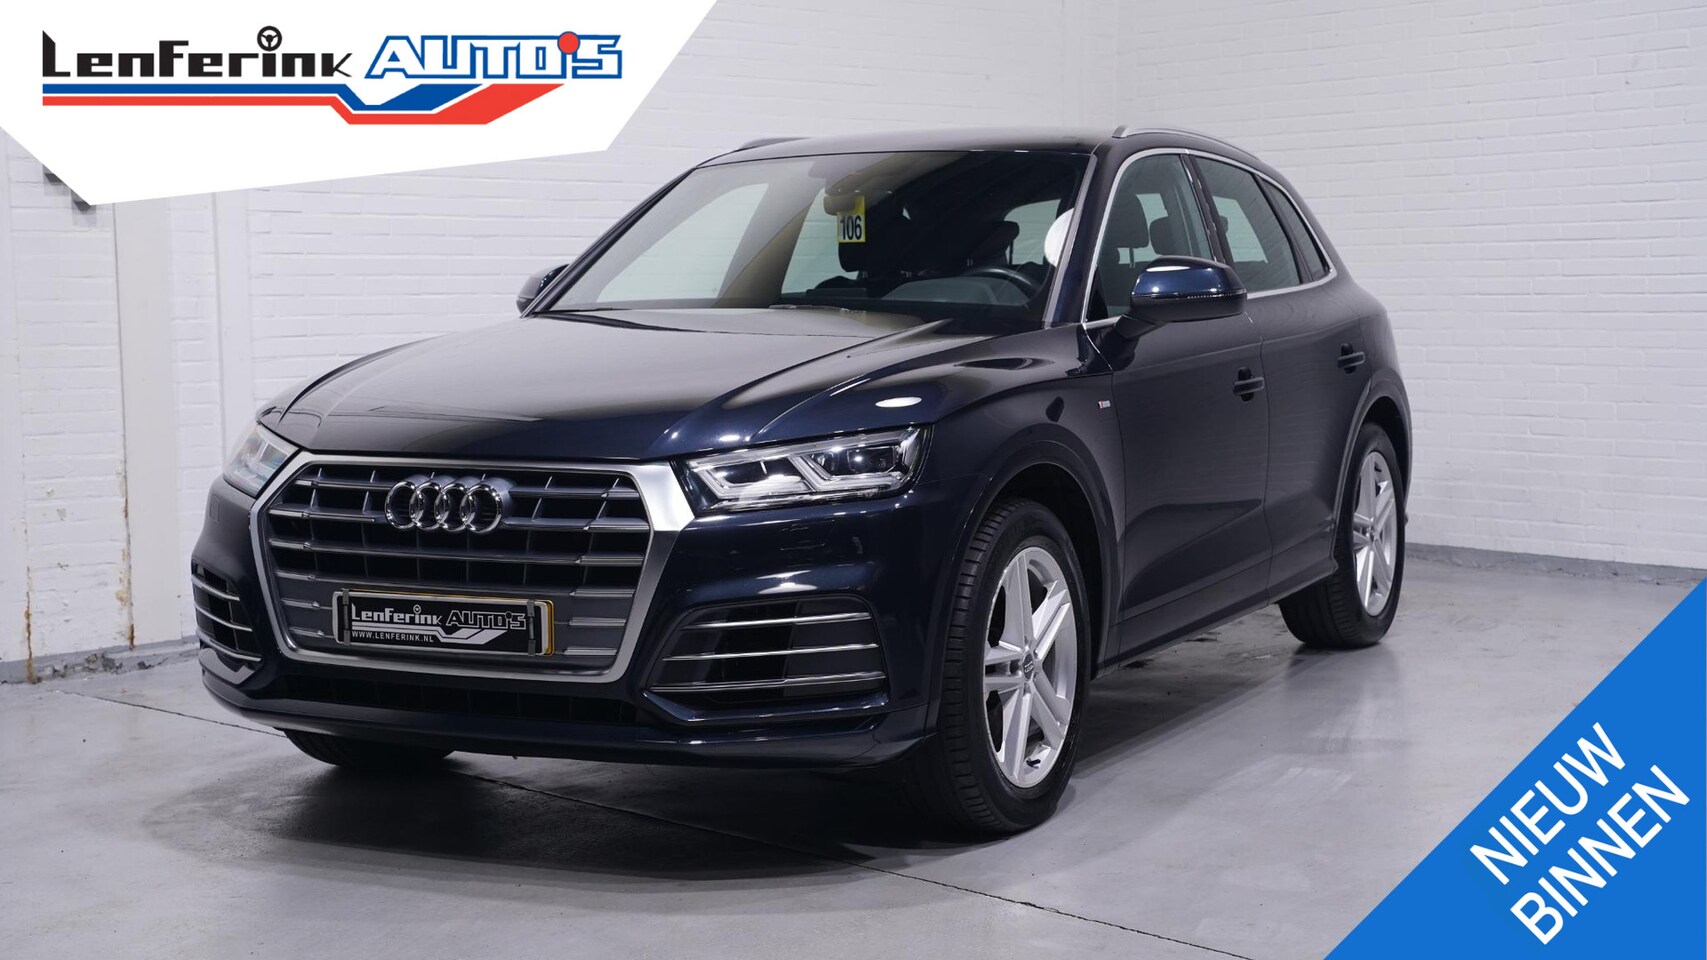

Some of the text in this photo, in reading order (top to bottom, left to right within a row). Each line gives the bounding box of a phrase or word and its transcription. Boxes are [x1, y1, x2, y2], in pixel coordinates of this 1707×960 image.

[840, 215, 862, 240] 106
[446, 610, 526, 630] AUTO'S
[352, 630, 434, 643] WWW.LENFERINK.NL
